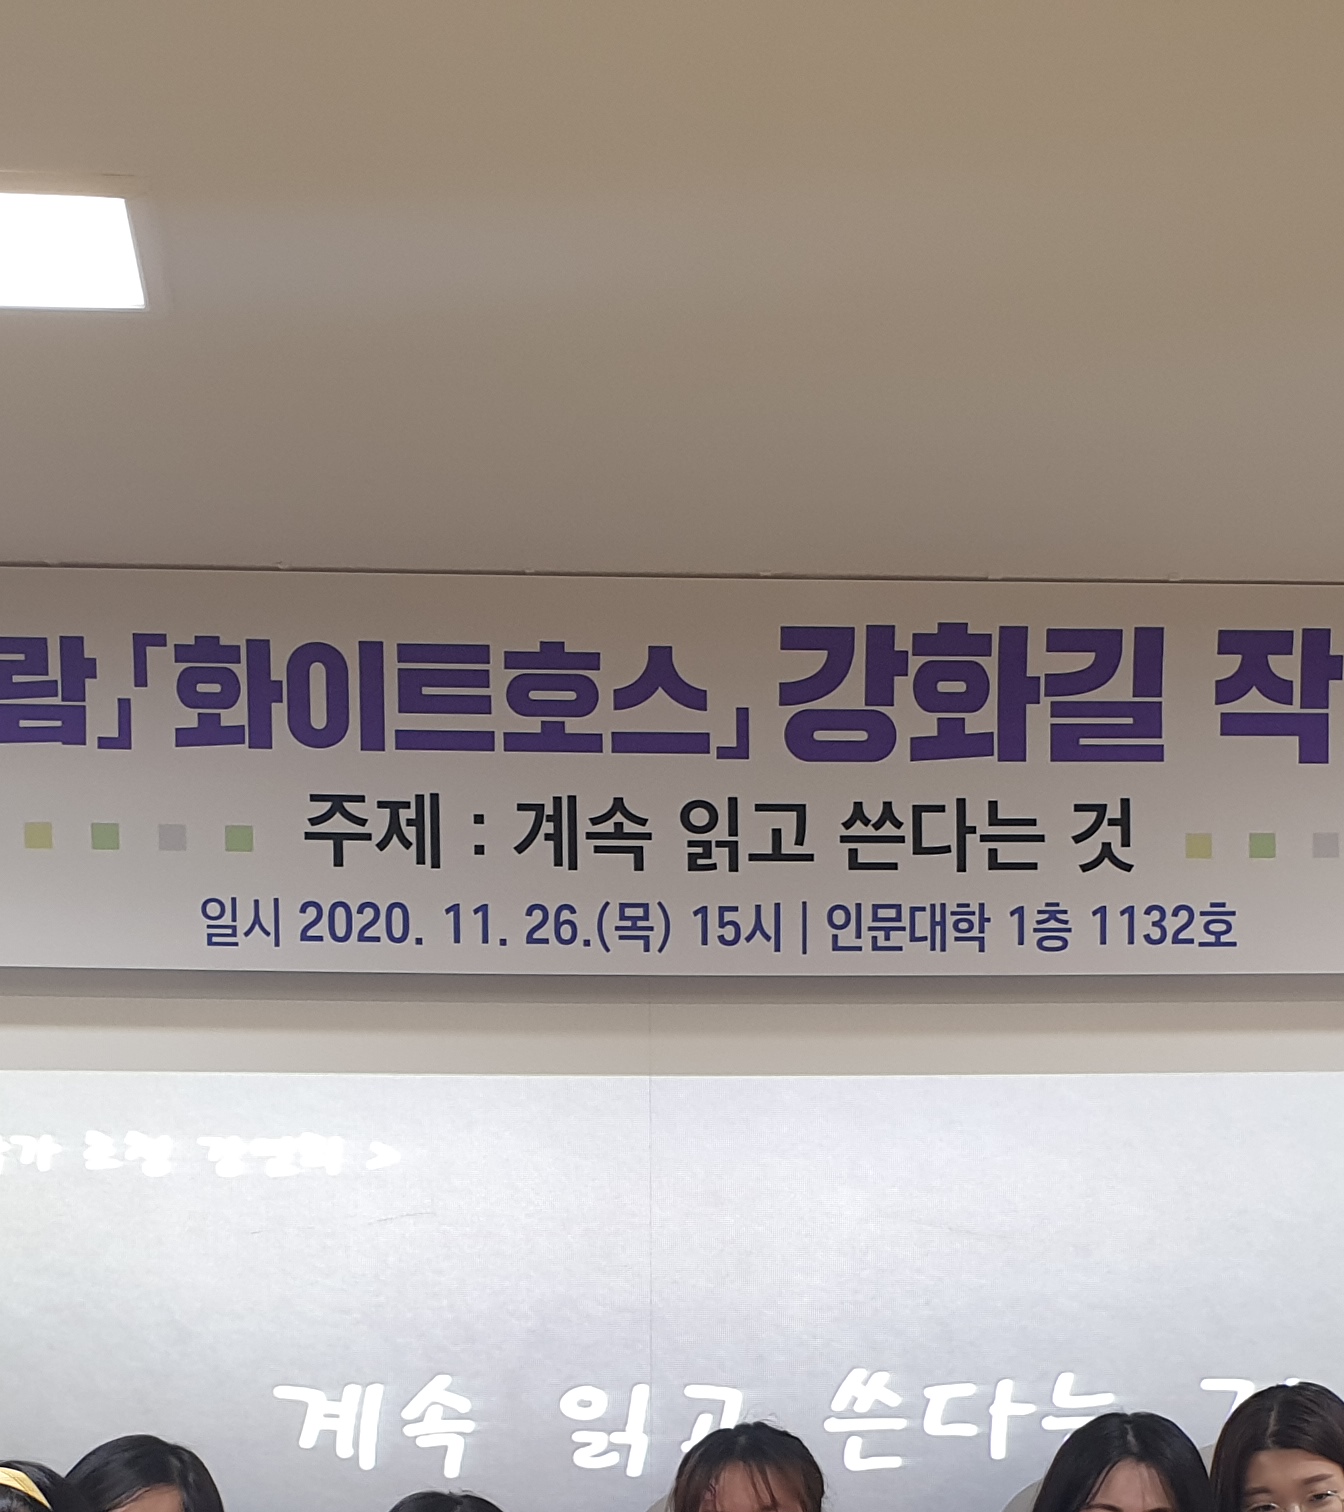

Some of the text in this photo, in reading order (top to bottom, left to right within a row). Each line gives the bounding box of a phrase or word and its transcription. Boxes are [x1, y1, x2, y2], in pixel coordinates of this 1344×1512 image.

[777, 621, 1166, 764] 강화길
[302, 791, 442, 870] 주제
[512, 793, 654, 873] 계속
[678, 795, 816, 874] 읽고
[838, 796, 1047, 874] 쓴다는
[1070, 796, 1136, 874] 것
[199, 895, 282, 949] 일시
[297, 899, 424, 947] 2020.
[444, 901, 509, 948] 11.
[523, 899, 672, 955] 26.(목)
[691, 900, 783, 954] 15시
[825, 901, 993, 954] 인문대학
[1008, 900, 1074, 954] 1층
[1090, 900, 1239, 951] 1132호
[272, 1373, 477, 1480] 계속
